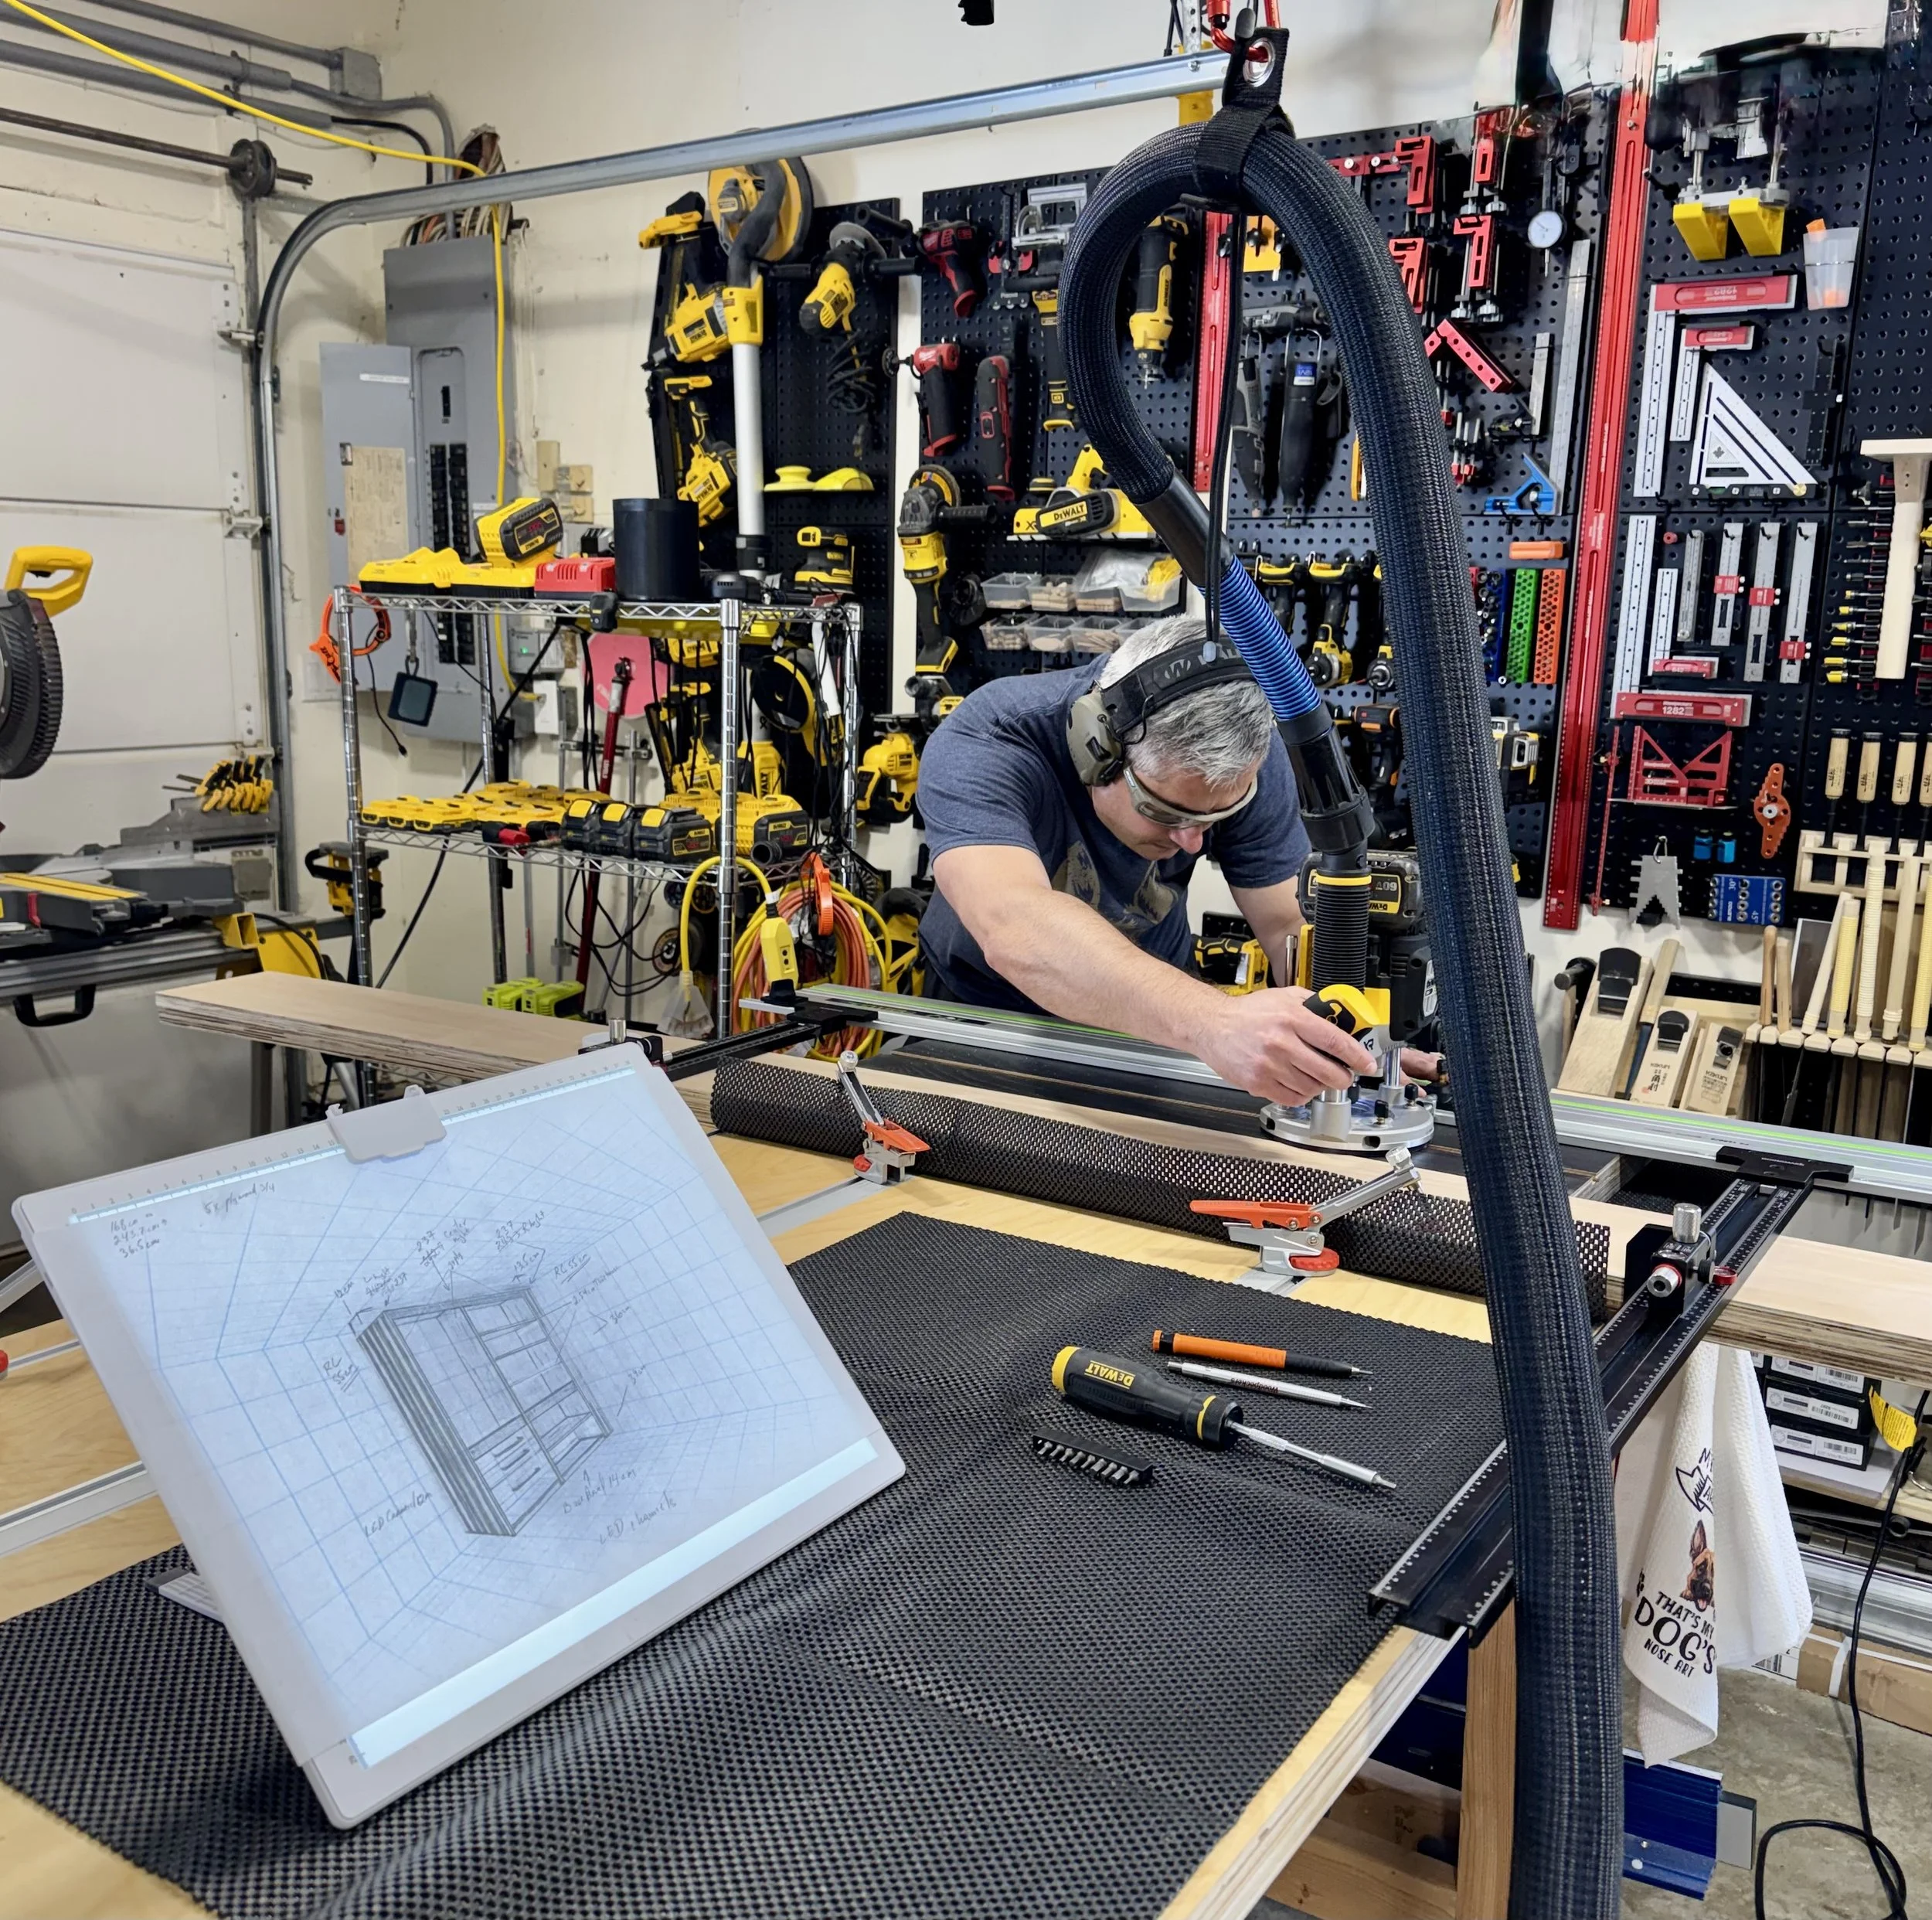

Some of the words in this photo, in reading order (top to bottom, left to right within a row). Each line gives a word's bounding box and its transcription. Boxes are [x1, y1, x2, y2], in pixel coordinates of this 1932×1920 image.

[1655, 1591, 1701, 1629] THAT'S
[1634, 1596, 1716, 1675] DOG'S
[1644, 1638, 1671, 1666] NOSE
[1674, 1659, 1695, 1679] ART
